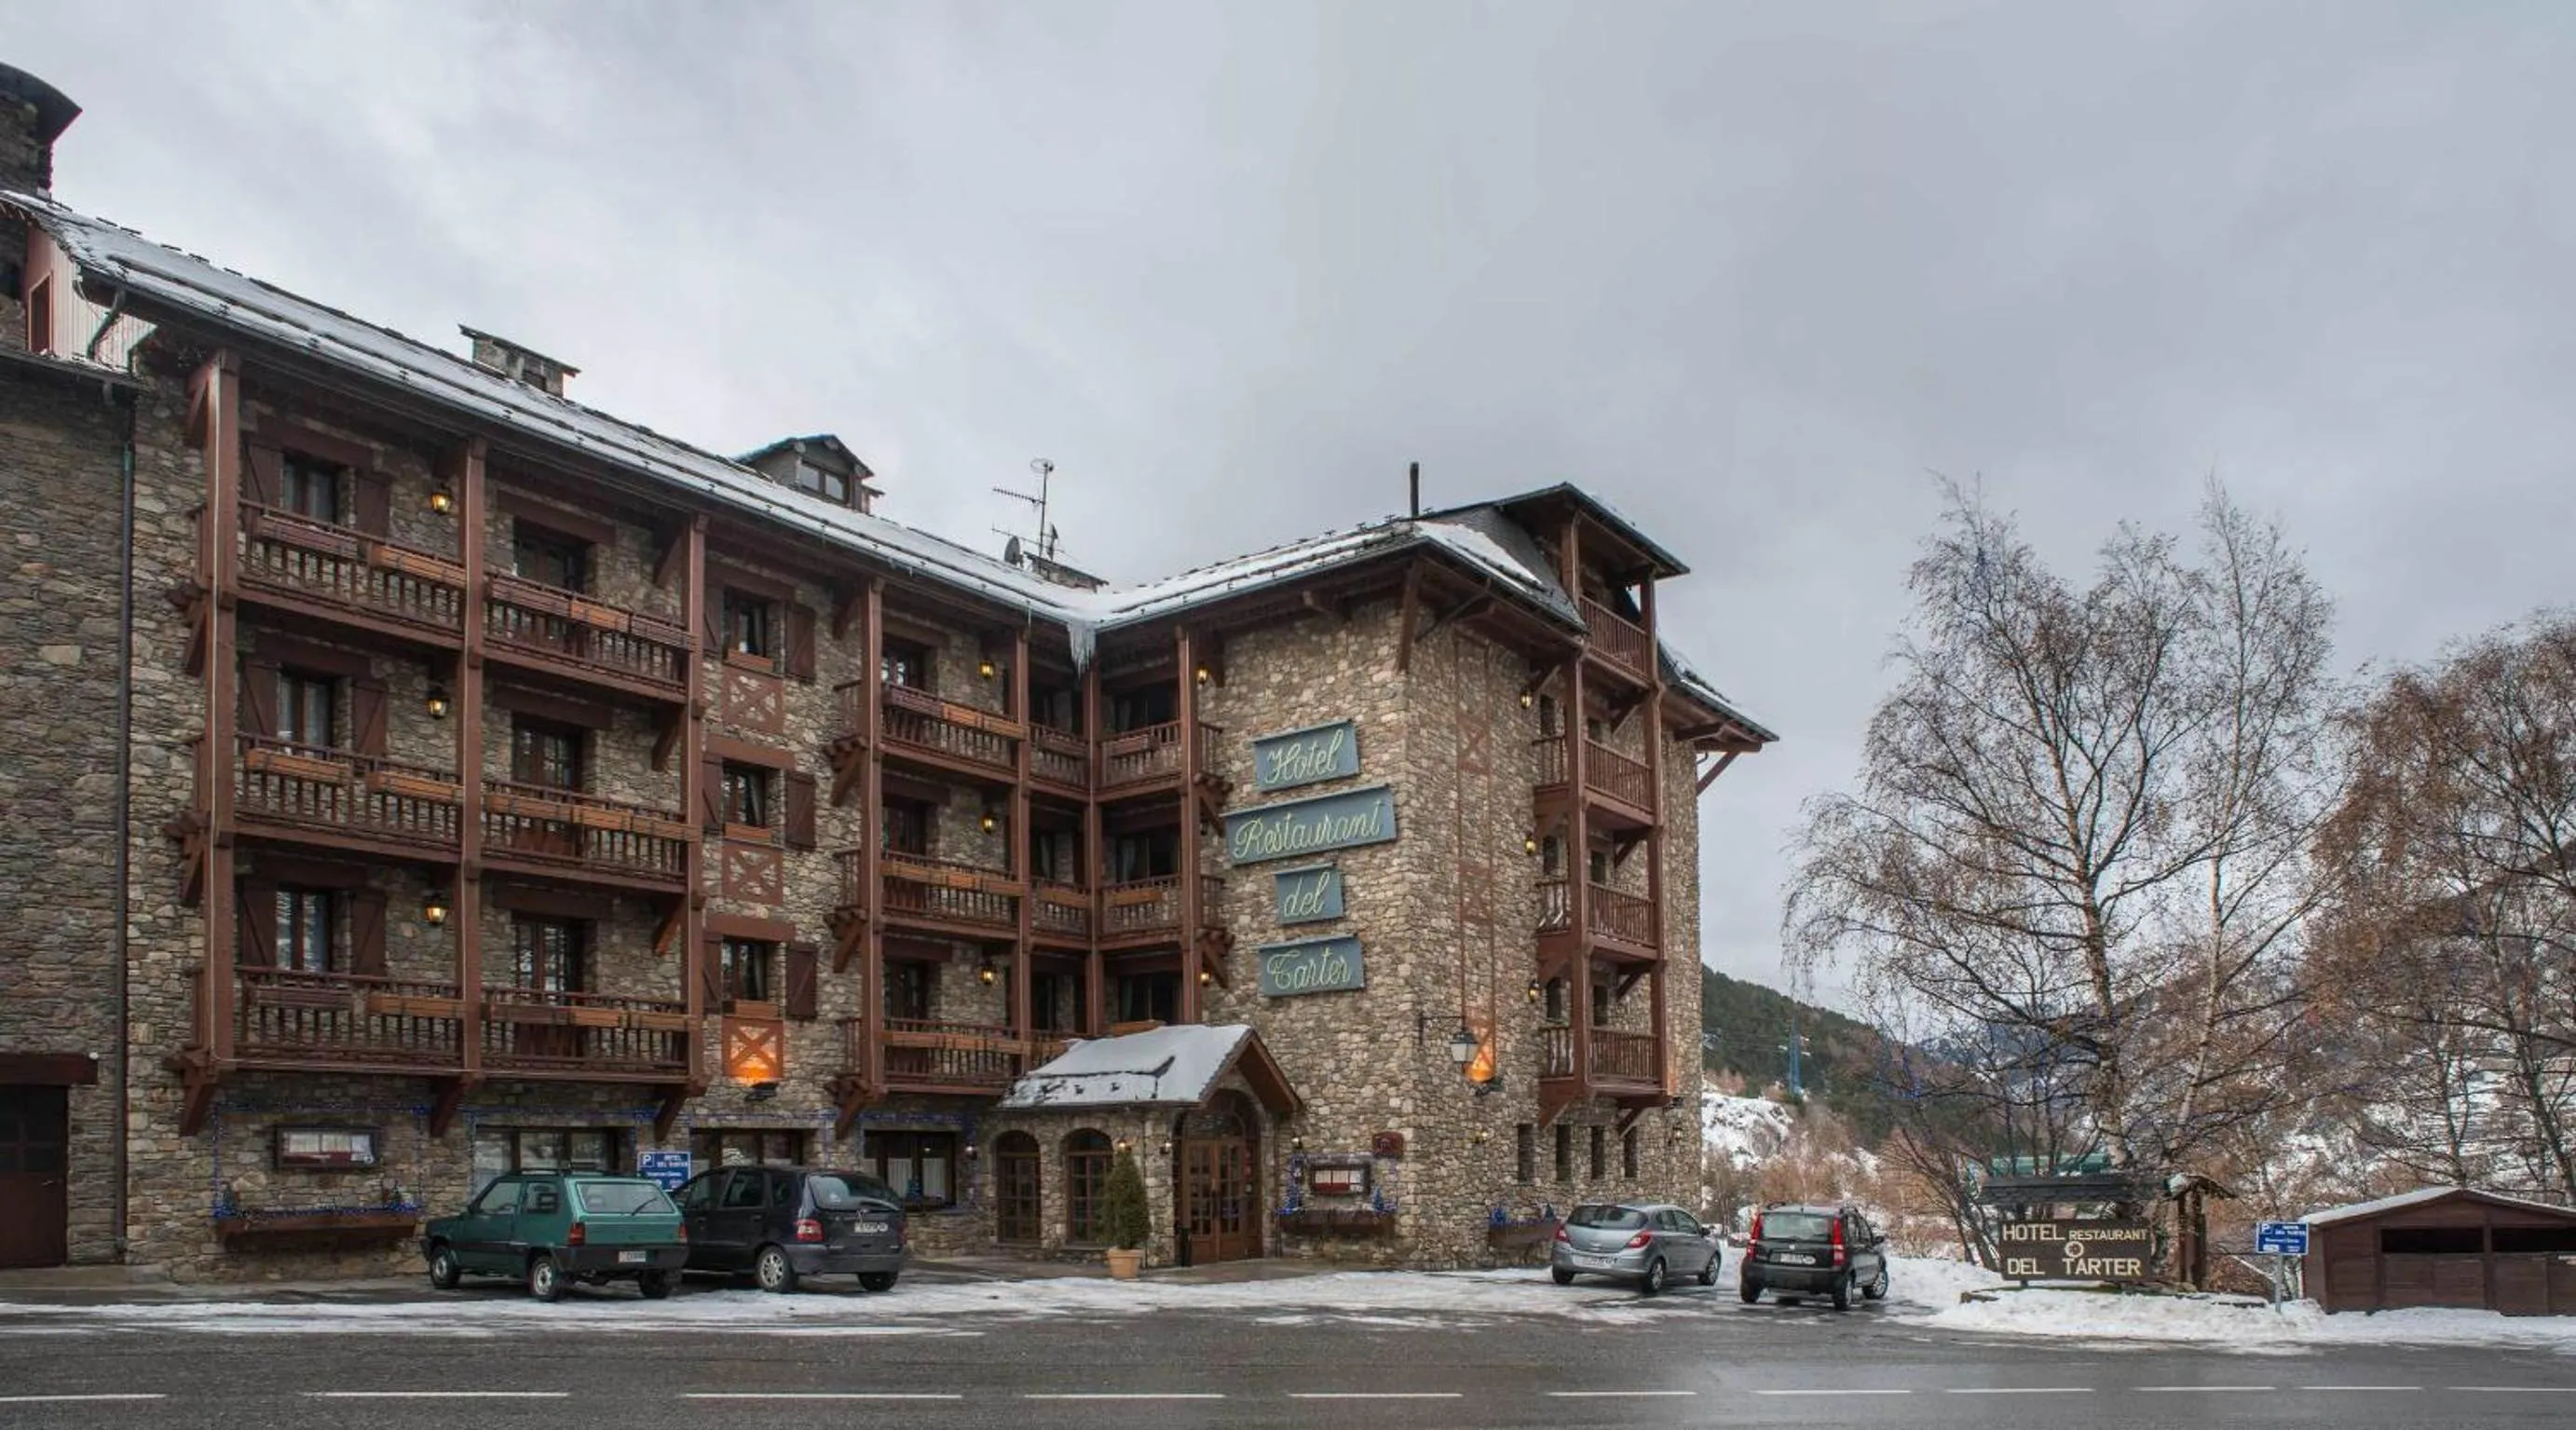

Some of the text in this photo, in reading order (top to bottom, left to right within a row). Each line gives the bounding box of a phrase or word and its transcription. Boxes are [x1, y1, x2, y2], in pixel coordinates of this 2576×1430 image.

[1264, 729, 1344, 784] Hotel
[1233, 799, 1384, 859] Restaurant
[1283, 871, 1330, 918] del
[1266, 947, 1351, 990] Tarter
[643, 1154, 652, 1165] P
[2003, 1223, 2147, 1241] HOTEL RESTAURANT
[2261, 1222, 2270, 1233] P
[2007, 1258, 2142, 1276] DEL TARTER
